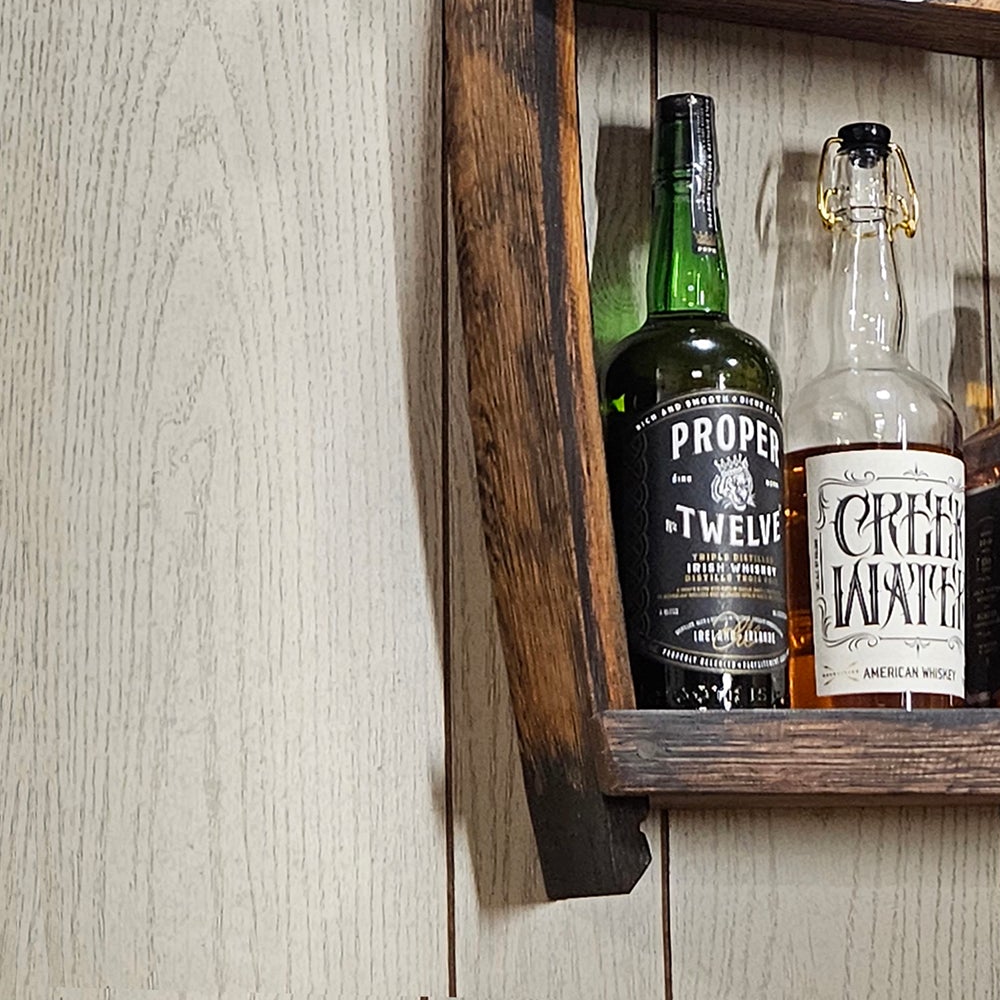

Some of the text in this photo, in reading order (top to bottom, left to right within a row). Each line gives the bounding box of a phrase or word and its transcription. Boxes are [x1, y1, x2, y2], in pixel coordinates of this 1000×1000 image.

[660, 403, 683, 417] AND
[686, 395, 730, 408] SMOOTH
[671, 414, 780, 469] PROPER
[675, 504, 781, 547] TWELVE
[686, 562, 725, 574] IRISH
[863, 666, 918, 679] AMERICAN
[921, 667, 956, 681] WHISKEY
